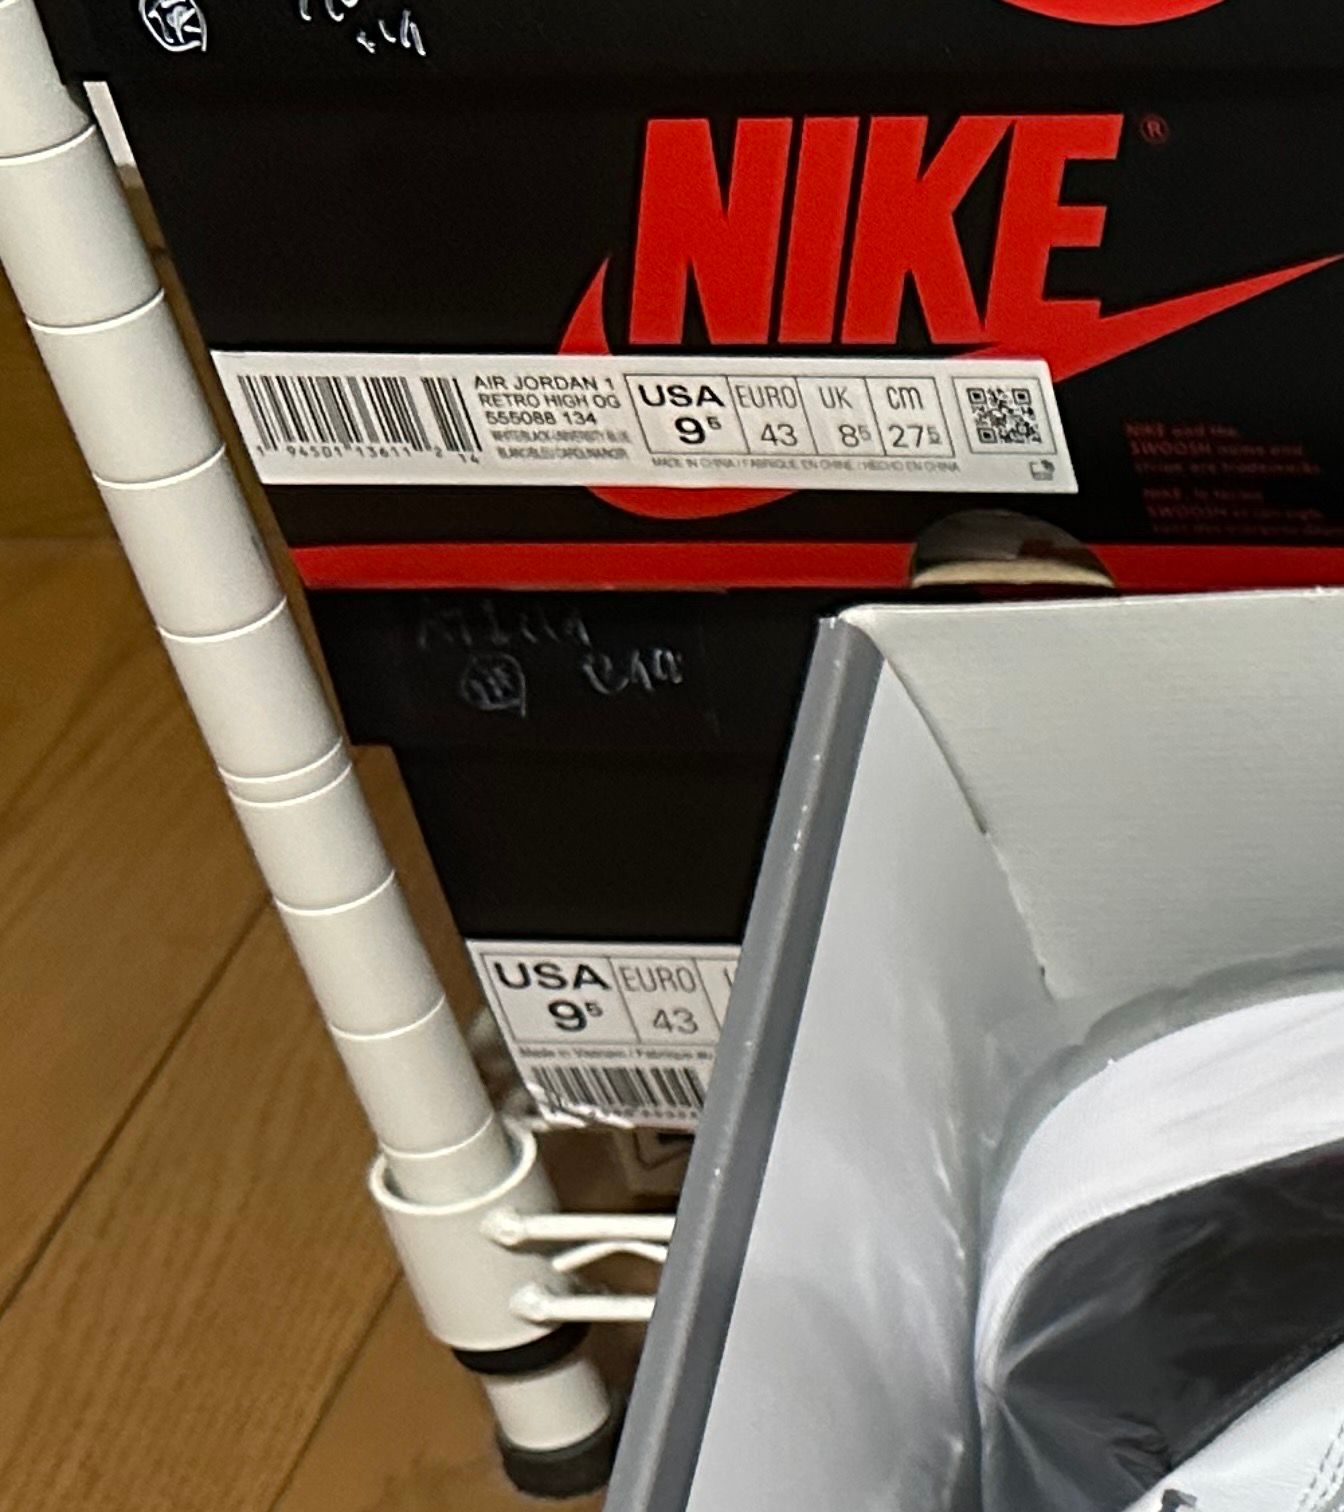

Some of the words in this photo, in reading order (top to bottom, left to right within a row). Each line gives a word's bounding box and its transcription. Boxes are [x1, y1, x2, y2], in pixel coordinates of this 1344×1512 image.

[630, 114, 1124, 344] NIKE
[474, 376, 507, 391] AIR
[513, 375, 602, 391] JORDAN
[605, 376, 615, 391] 1
[479, 393, 540, 409] RETRO
[544, 393, 591, 409] HIGH
[593, 393, 622, 409] OG
[637, 384, 725, 408] USA
[738, 385, 800, 410] EURO
[819, 386, 854, 410] UK
[486, 411, 557, 426] 555088
[563, 411, 598, 426] 134
[760, 422, 798, 448] 43
[494, 962, 612, 990] USA
[619, 966, 697, 993] EURO
[653, 1008, 698, 1034] 43
